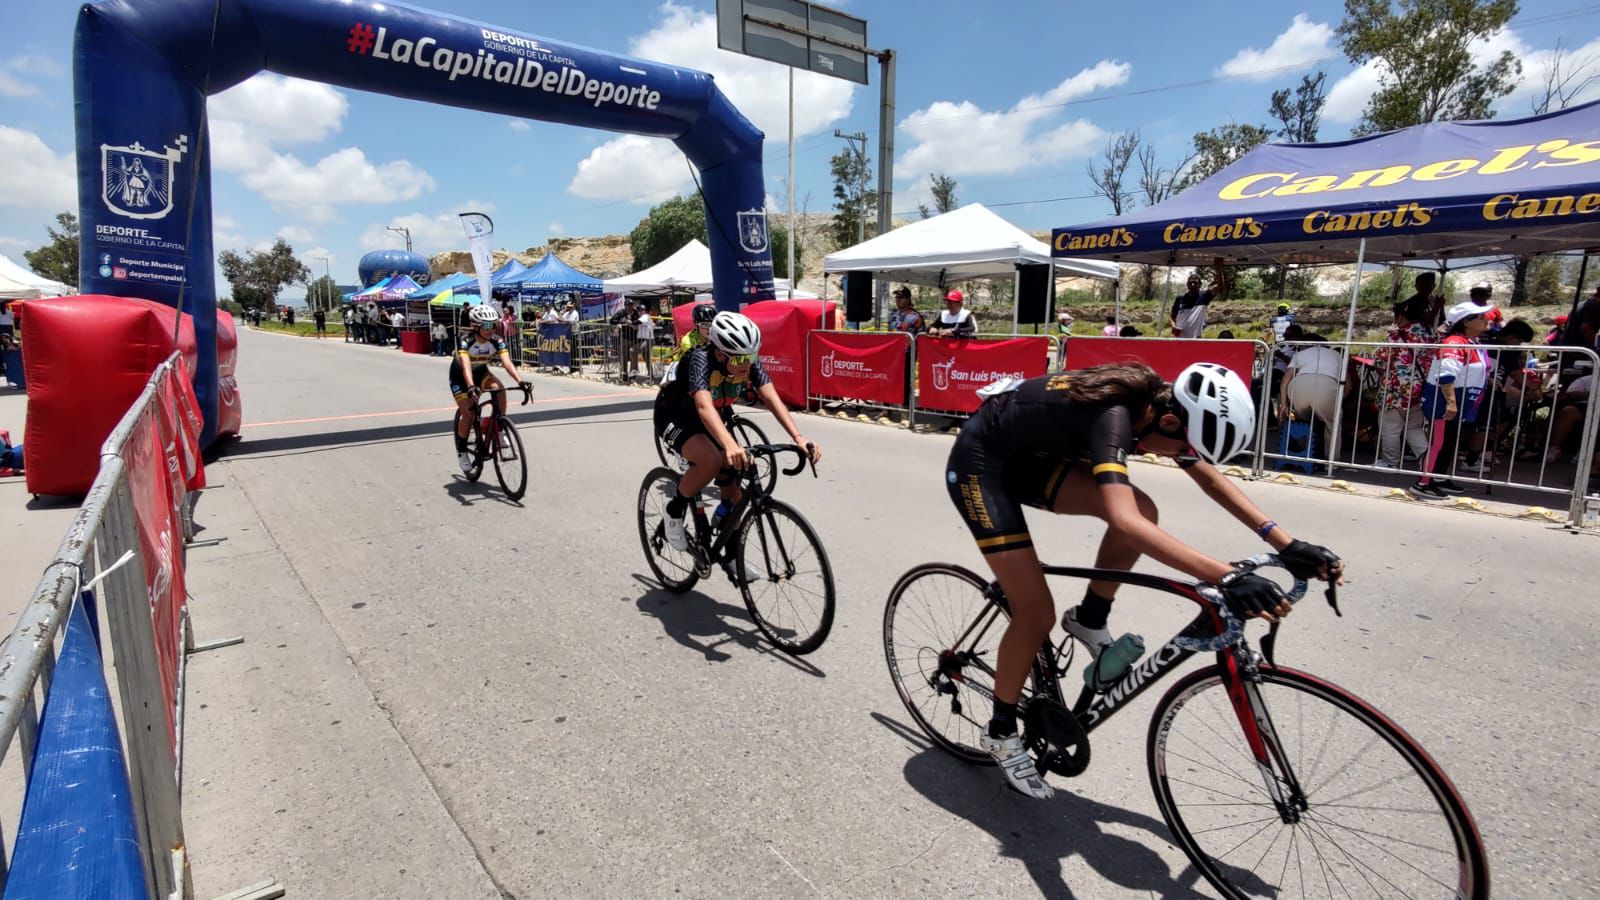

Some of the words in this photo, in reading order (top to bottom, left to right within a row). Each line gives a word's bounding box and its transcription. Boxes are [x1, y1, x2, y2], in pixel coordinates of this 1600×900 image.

[481, 29, 539, 50] DEPORTE
[483, 40, 525, 56] GOBIERNO
[526, 50, 537, 59] DE
[538, 53, 548, 62] LA
[548, 54, 577, 67] CAPITAL
[347, 22, 661, 110] #LaCapitalDelDeporte
[1219, 139, 1600, 201] Canel's
[96, 224, 149, 238] DEPORTE
[1054, 226, 1135, 251] Canel's
[1163, 217, 1265, 244] Canel's
[1302, 202, 1434, 234] Canel's
[96, 234, 132, 244] GOBIERNO
[133, 238, 144, 246] DE
[157, 241, 185, 251] CAPITAL
[119, 257, 150, 267] Deporte
[151, 261, 185, 271] Municipa
[537, 334, 571, 353] Canel's
[834, 360, 864, 370] DEPORTE
[951, 370, 968, 381] San
[970, 370, 988, 382] Luis
[1087, 643, 1181, 725] S-WORKS
